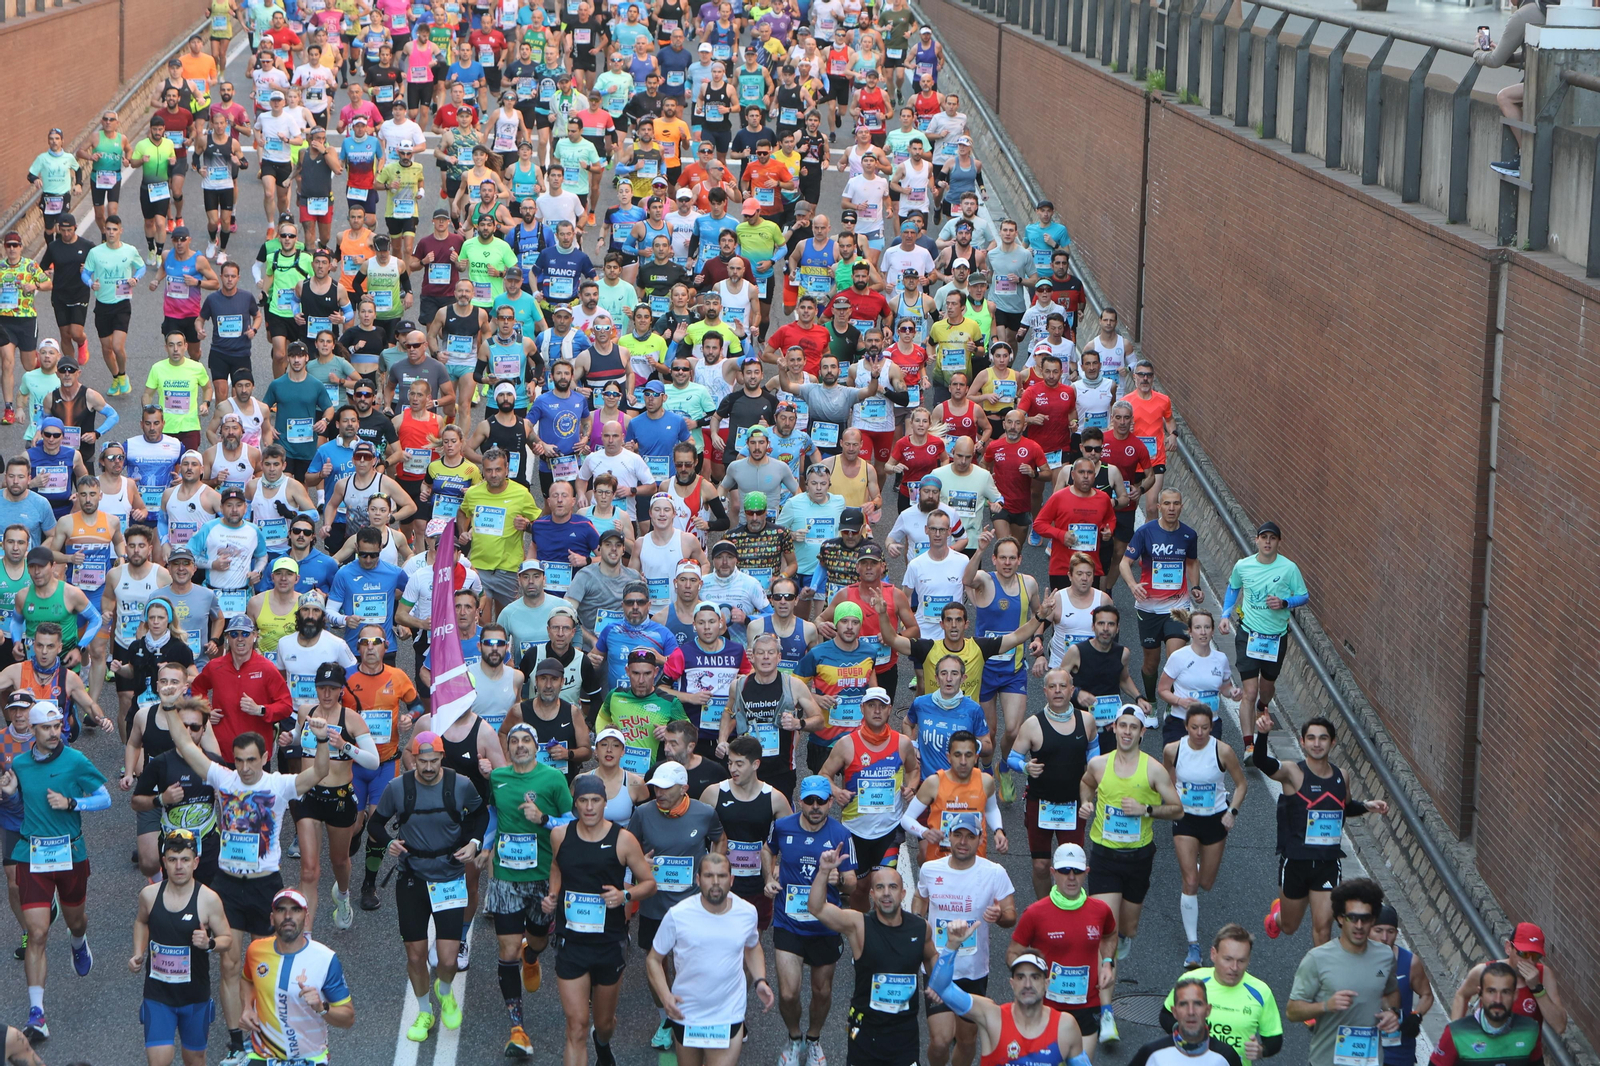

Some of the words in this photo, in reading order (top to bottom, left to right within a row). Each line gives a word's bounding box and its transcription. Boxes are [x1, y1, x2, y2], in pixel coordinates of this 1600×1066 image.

[548, 267, 576, 277] FRANCE
[1152, 543, 1173, 555] RAC
[122, 600, 144, 611] hde
[696, 656, 736, 666] XANDER
[837, 668, 863, 676] NEVER
[837, 678, 855, 687] GIVE
[856, 678, 867, 686] UP
[619, 715, 649, 728] RUN
[860, 769, 895, 777] PALACIEGO
